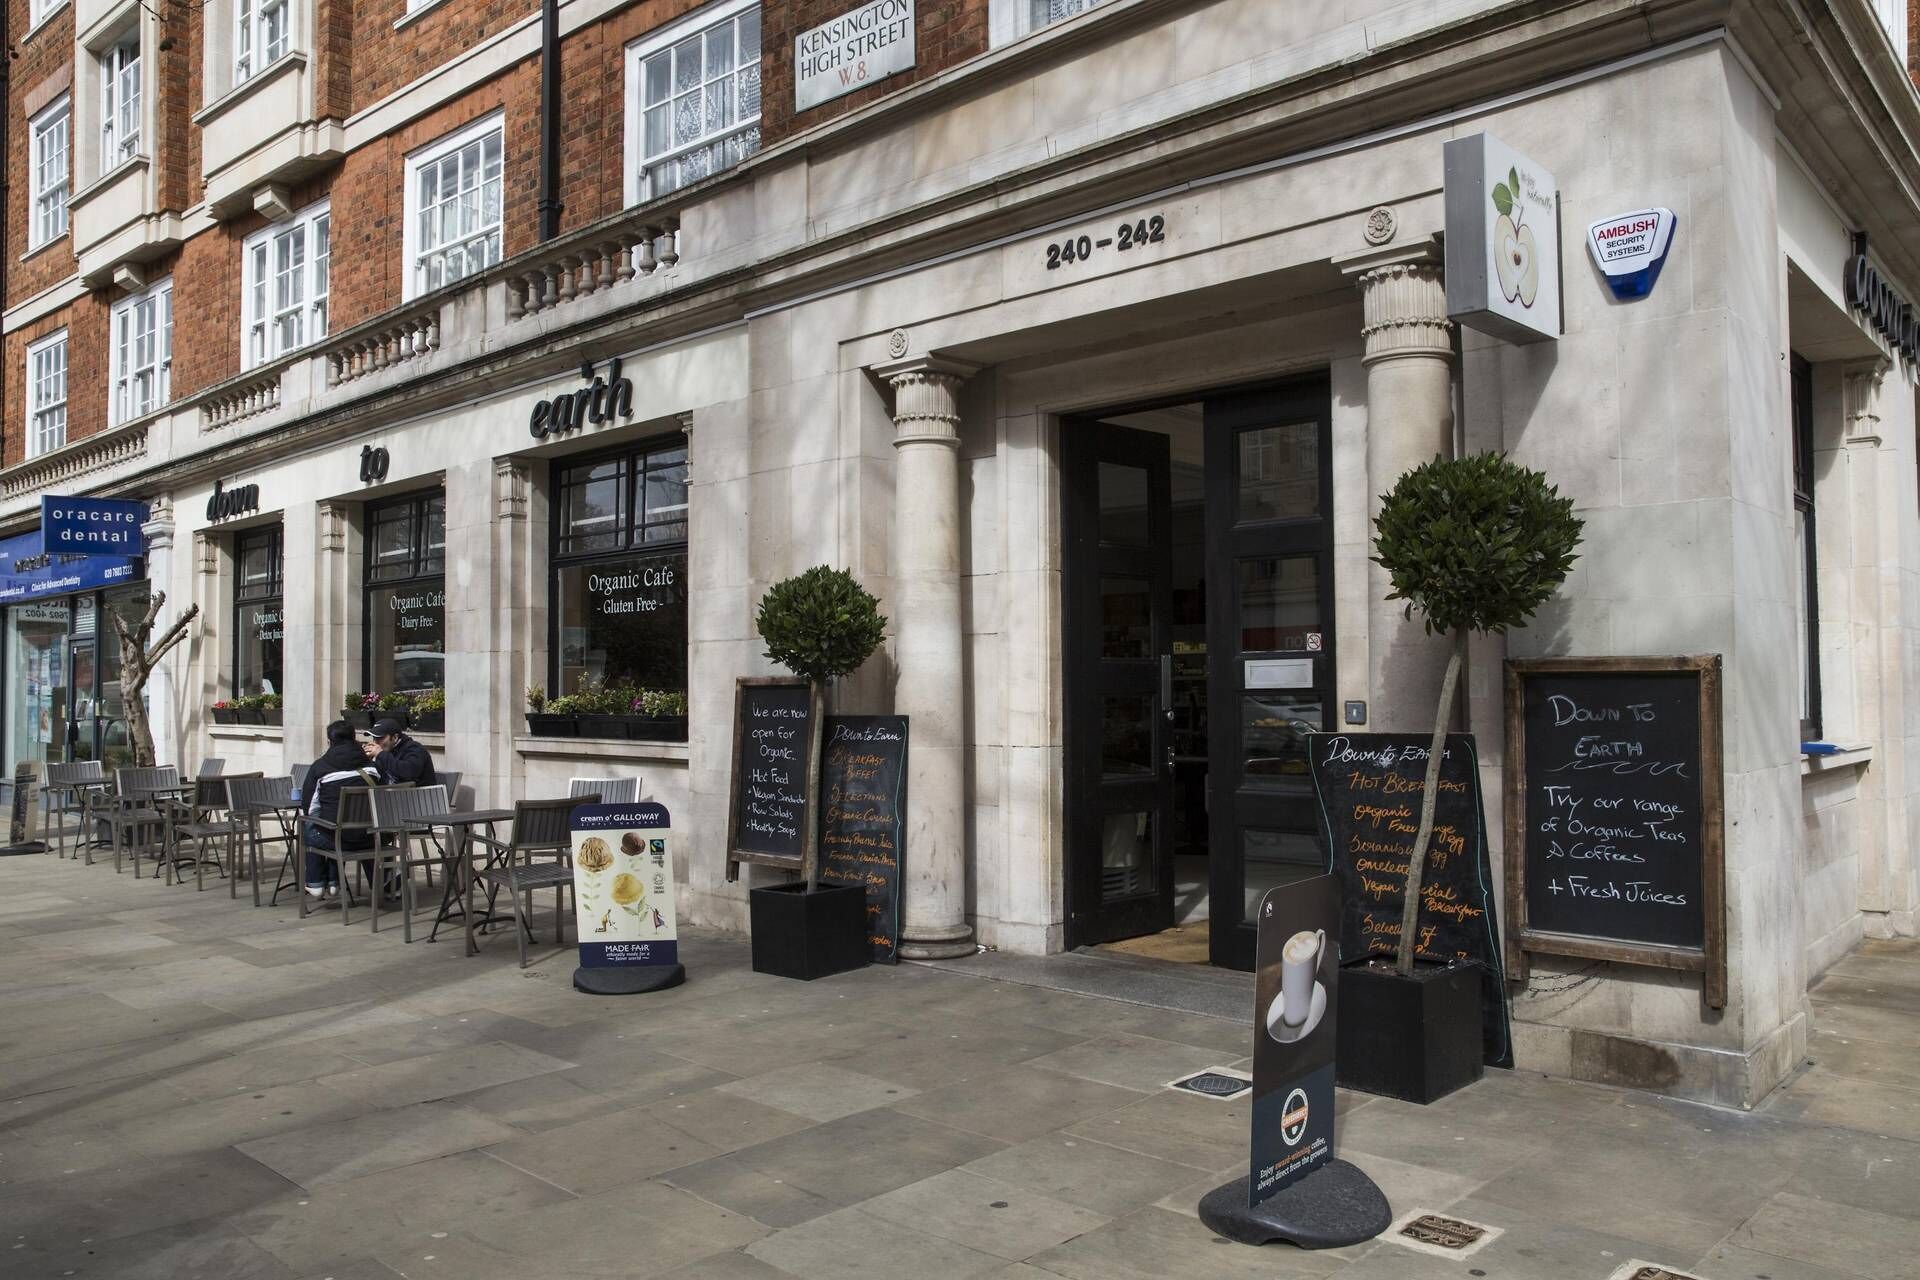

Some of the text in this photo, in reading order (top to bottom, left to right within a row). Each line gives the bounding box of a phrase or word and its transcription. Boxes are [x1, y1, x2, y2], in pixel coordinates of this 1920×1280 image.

[801, 0, 908, 57] KENSINGTON
[801, 17, 910, 80] HIGH STREET
[1597, 218, 1655, 241] AMBUSH
[1606, 234, 1646, 249] SECURITY
[1607, 244, 1645, 258] SYSTEMS
[530, 358, 633, 438] earth
[360, 445, 390, 483] to
[207, 480, 260, 521] down
[52, 509, 135, 523] oracare
[60, 528, 128, 543] dental
[589, 566, 673, 595] Organic Cafe
[390, 593, 423, 613] Organic
[603, 597, 657, 614] Gluten Free
[401, 616, 433, 630] Dairy Free
[753, 701, 808, 718] We are now
[752, 730, 774, 744] open
[1323, 736, 1382, 767] Down
[1380, 745, 1396, 764] to
[753, 768, 789, 784] Hot Food
[1383, 772, 1468, 793] BREAFAST
[752, 785, 776, 802] Vegan
[1544, 786, 1685, 821] Try our range
[613, 812, 660, 822] GALLOWAY
[752, 803, 793, 820] Raw Salads
[1353, 804, 1413, 828] Organic
[751, 818, 797, 839] Healthy Soups
[1541, 817, 1688, 844] of Organic Teas
[1448, 834, 1465, 857] egg
[1570, 842, 1646, 863] Coffees
[1362, 876, 1400, 901] Vegan
[1548, 875, 1687, 905] + Fresh Juices
[1420, 925, 1438, 946] of
[605, 944, 650, 953] MADE FAIR
[1259, 1166, 1275, 1178] Enjoy
[1274, 1145, 1312, 1170] award-winning
[1257, 1175, 1276, 1191] always
[1275, 1166, 1290, 1180] direct
[1290, 1161, 1302, 1172] from
[1301, 1155, 1310, 1165] the
